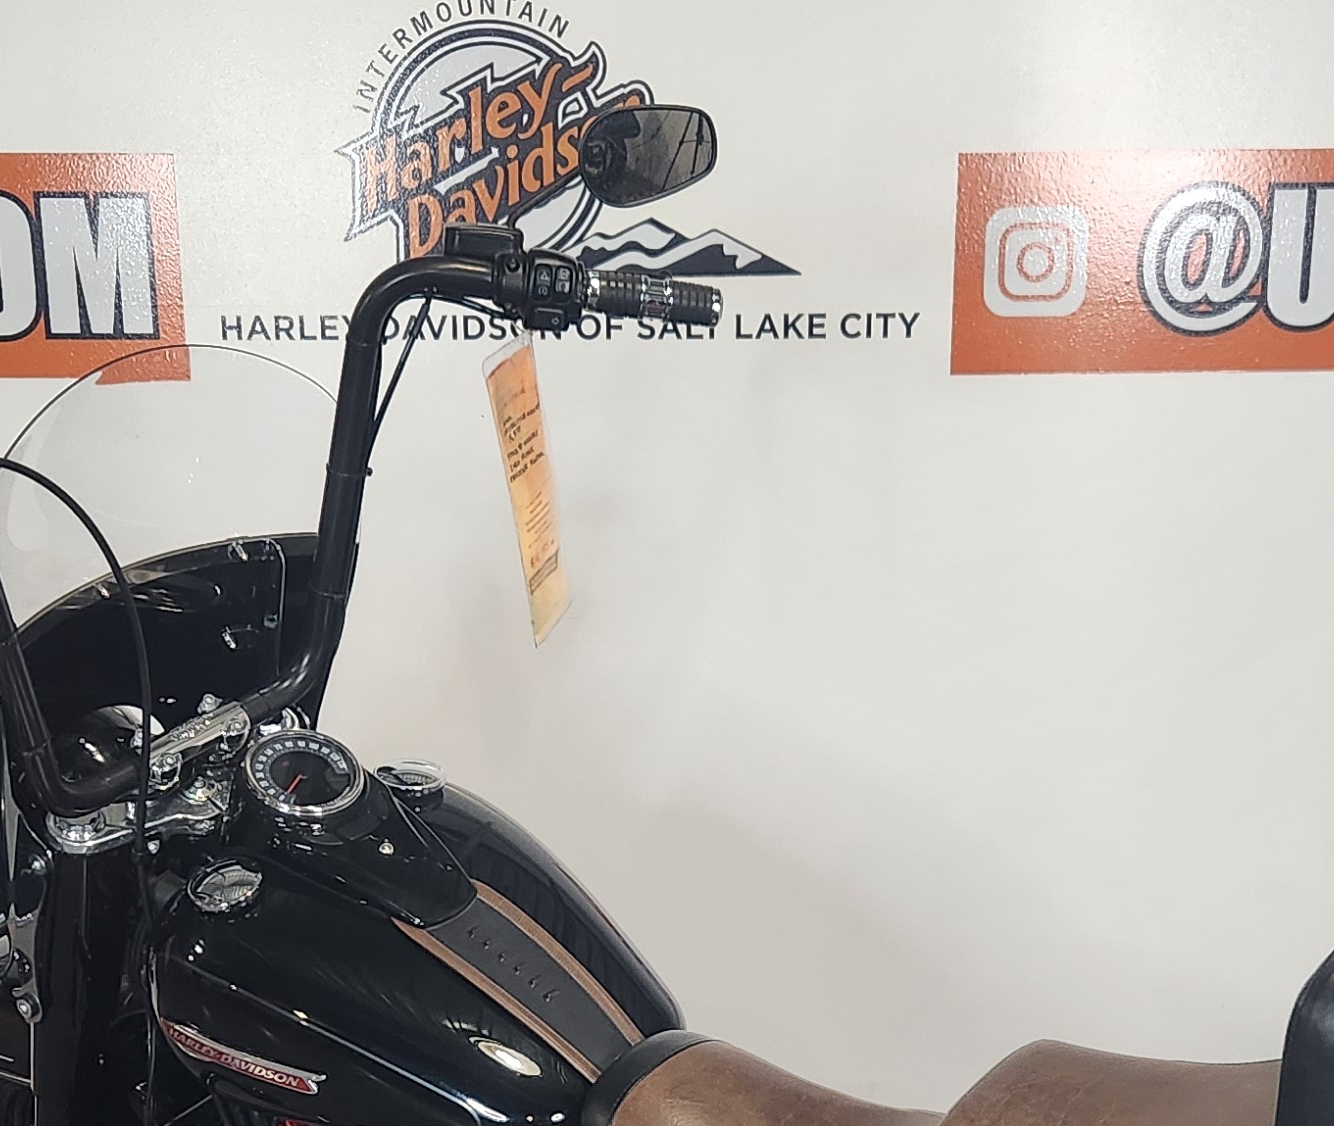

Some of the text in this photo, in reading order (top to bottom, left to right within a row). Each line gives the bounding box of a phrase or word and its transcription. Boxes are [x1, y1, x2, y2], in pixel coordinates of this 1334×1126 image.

[353, 0, 570, 114] INTERMOUNTAIN
[408, 94, 640, 259] Davids
[576, 314, 624, 341] OF
[734, 313, 827, 340] LAKE
[840, 312, 921, 339] CITY
[168, 1027, 299, 1087] HARLEY-DAVIDSON
